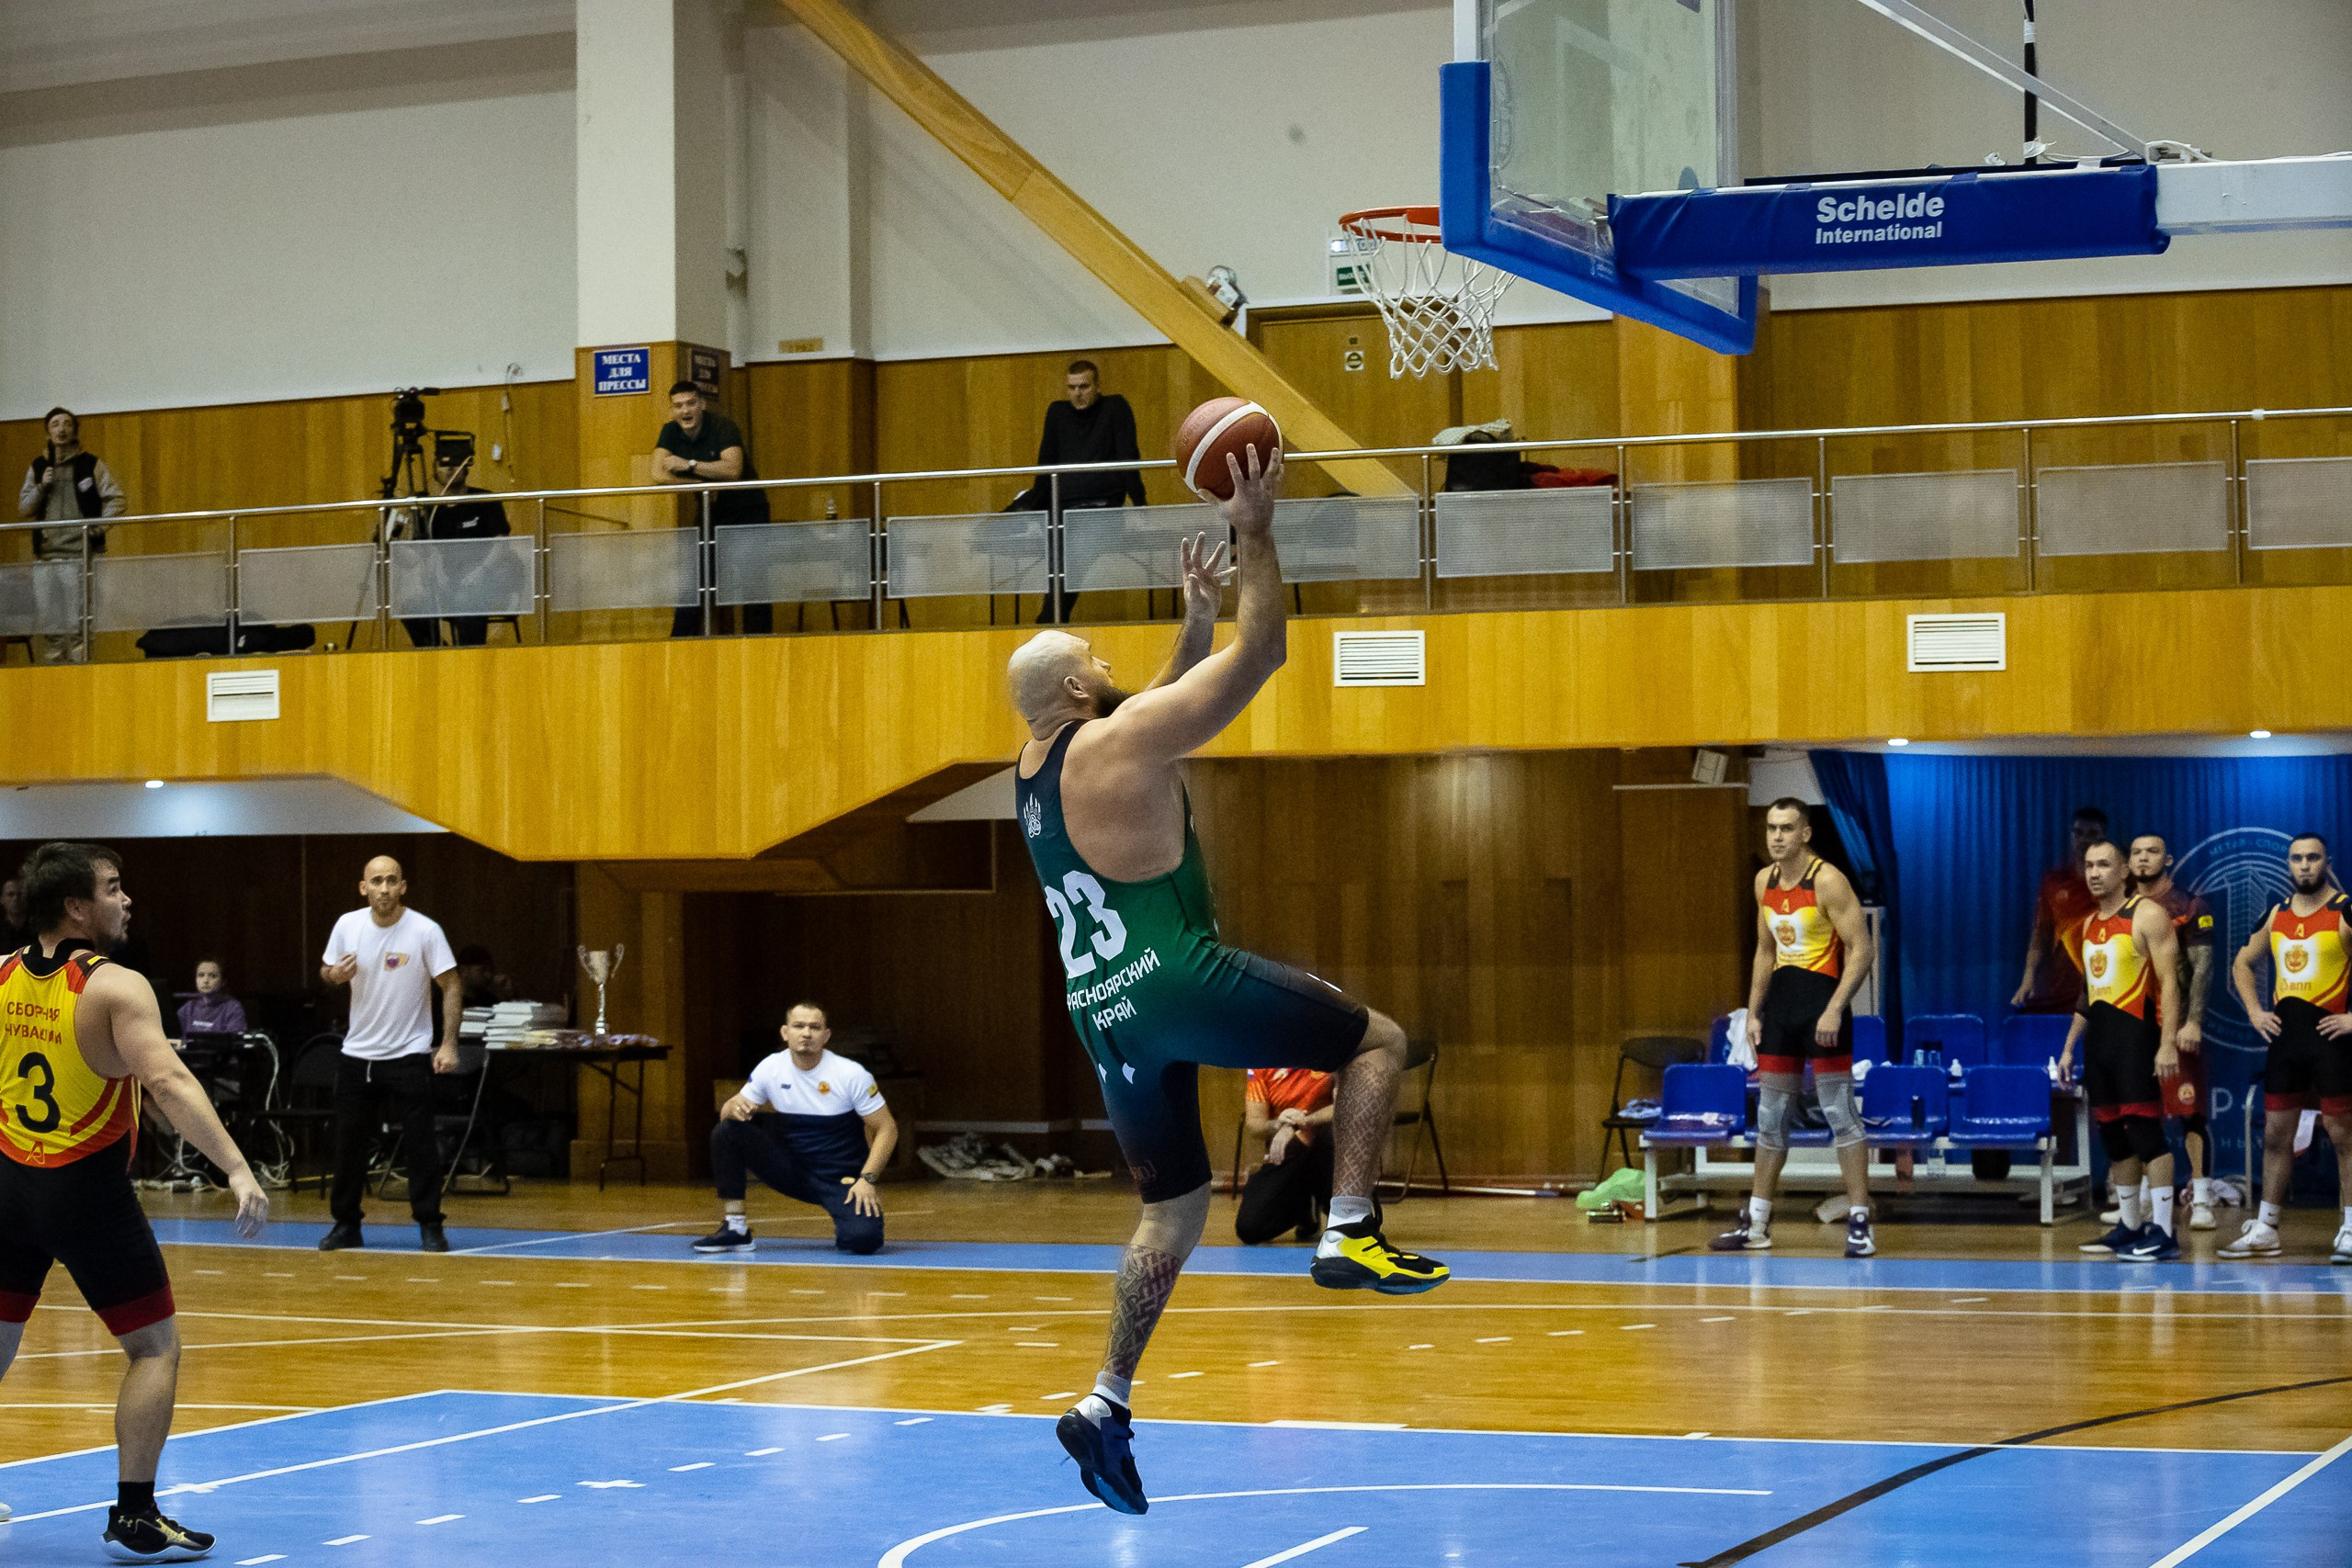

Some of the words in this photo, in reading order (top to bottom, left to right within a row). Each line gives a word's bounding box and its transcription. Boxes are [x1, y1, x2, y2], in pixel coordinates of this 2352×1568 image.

[1816, 192, 1945, 223] Schelde
[1815, 221, 1943, 244] International
[602, 353, 641, 365] МЕСТА
[608, 367, 633, 378] ДЛЯ
[598, 378, 647, 391] ПРЕССЫ
[1045, 870, 1127, 979] 23
[1067, 947, 1161, 1011] РАСНОЯРСКИЙ
[1091, 995, 1137, 1032] КРАЙ
[16, 1052, 61, 1134] 3
